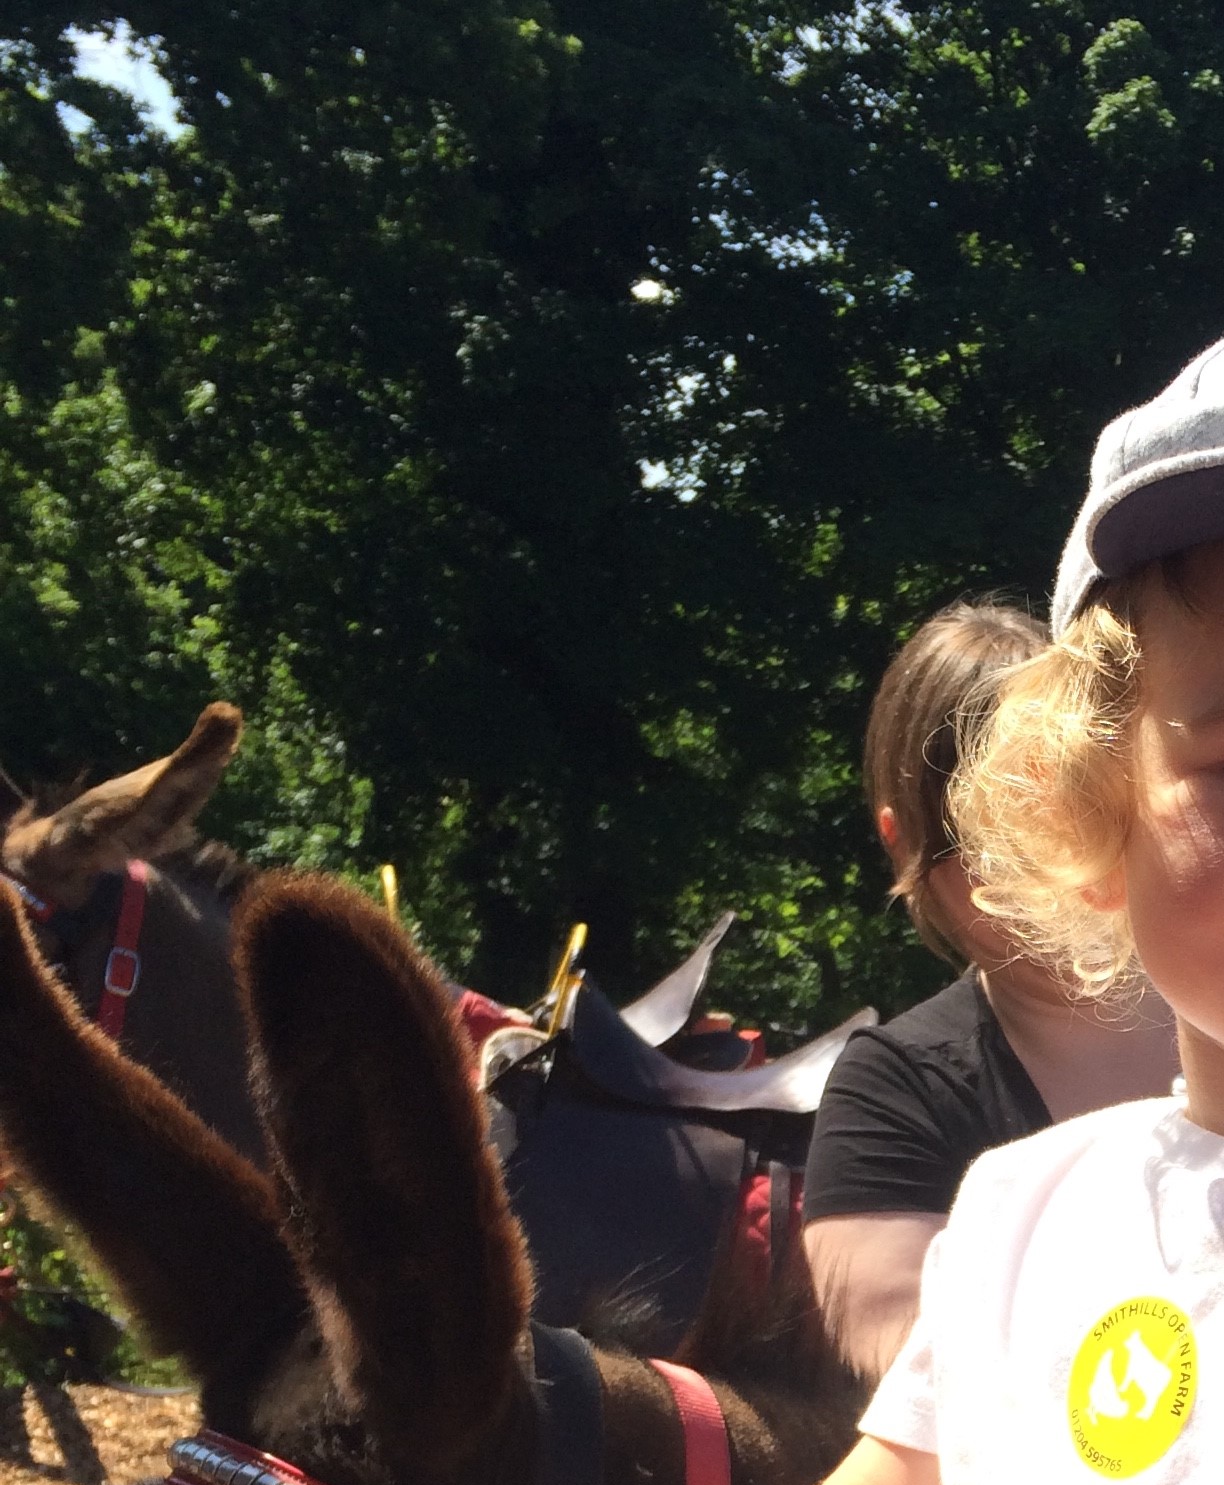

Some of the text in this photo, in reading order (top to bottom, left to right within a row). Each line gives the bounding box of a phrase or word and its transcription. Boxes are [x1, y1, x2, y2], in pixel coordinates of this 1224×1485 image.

[1094, 1303, 1191, 1417] SMITHILLS OPEN FARM
[1072, 1409, 1122, 1472] 01204 595765
